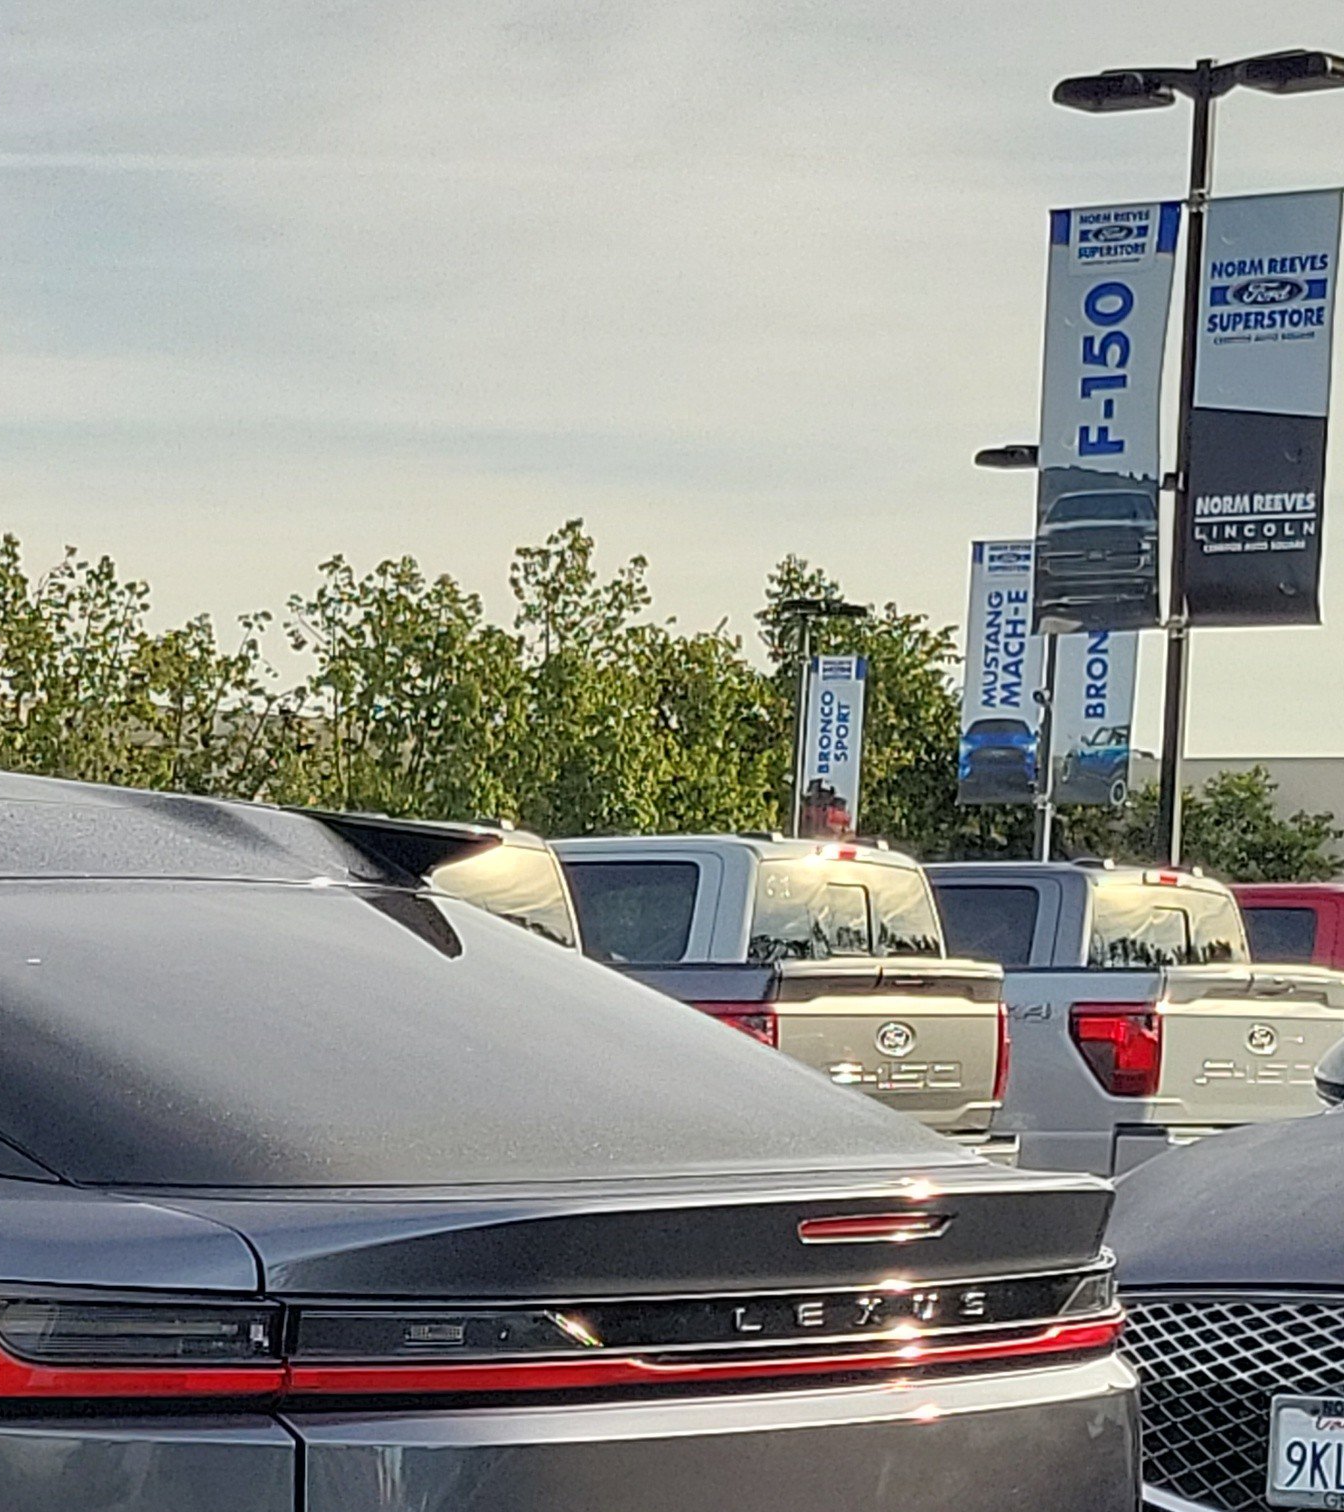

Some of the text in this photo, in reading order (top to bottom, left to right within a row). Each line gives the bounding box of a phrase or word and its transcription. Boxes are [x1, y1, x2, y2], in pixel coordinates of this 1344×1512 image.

[1211, 254, 1328, 279] NORM REEVES
[1242, 281, 1292, 304] Ford
[1207, 306, 1325, 333] SUPERSTORE
[1079, 281, 1134, 456] F-150
[1195, 493, 1316, 515] NORM REEVES
[1194, 522, 1316, 540] LINCOLN
[981, 590, 1004, 708] MUSTANG
[999, 590, 1028, 708] MACH-E
[818, 690, 834, 774] BRONCO
[834, 701, 850, 762] SPORT
[735, 1291, 987, 1332] LEXUS
